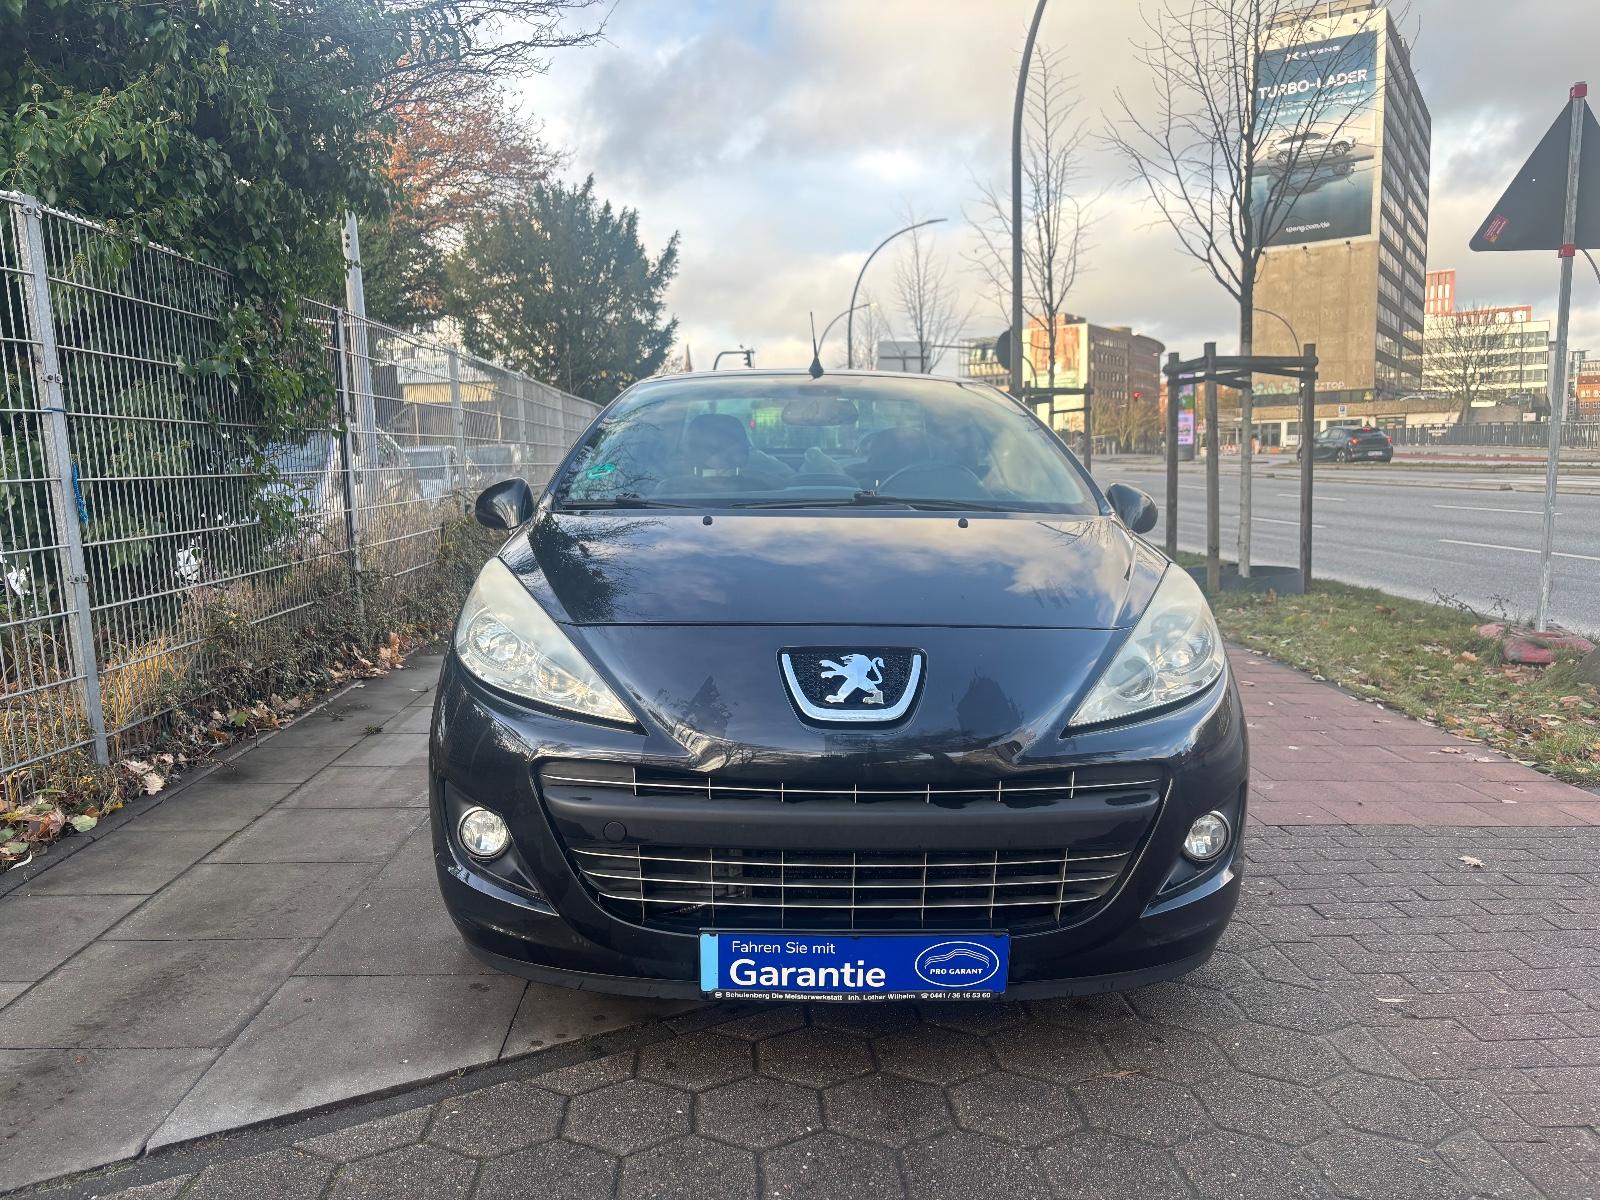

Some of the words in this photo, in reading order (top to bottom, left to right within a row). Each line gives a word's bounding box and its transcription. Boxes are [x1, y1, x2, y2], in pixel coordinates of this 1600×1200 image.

[1258, 69, 1367, 99] TURBO-LADER
[732, 941, 780, 953] Fahren
[786, 942, 808, 954] Sie
[813, 943, 836, 954] mit
[729, 958, 886, 987] Garantie
[725, 991, 770, 1000] Schulenberg
[785, 993, 843, 1001] Meisterwerkstatt
